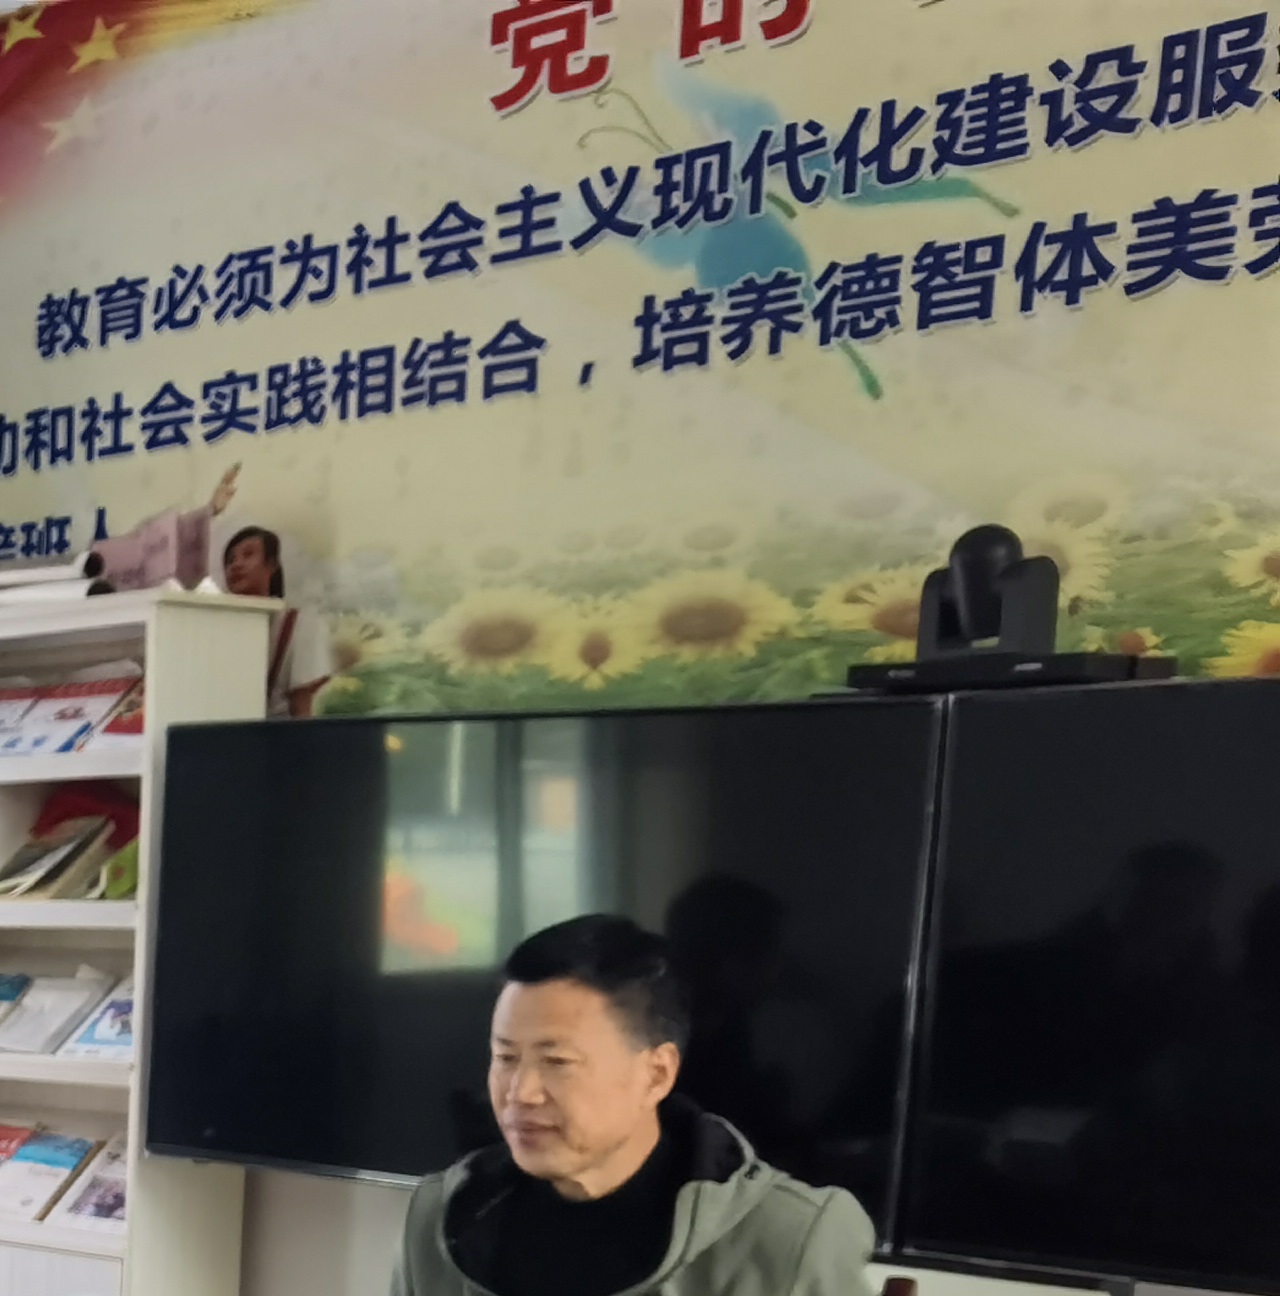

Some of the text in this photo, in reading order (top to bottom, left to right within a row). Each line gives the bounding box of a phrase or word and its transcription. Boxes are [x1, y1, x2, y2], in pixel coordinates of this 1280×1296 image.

[36, 12, 1280, 359] 教育必须为社会主义现代化建设服
